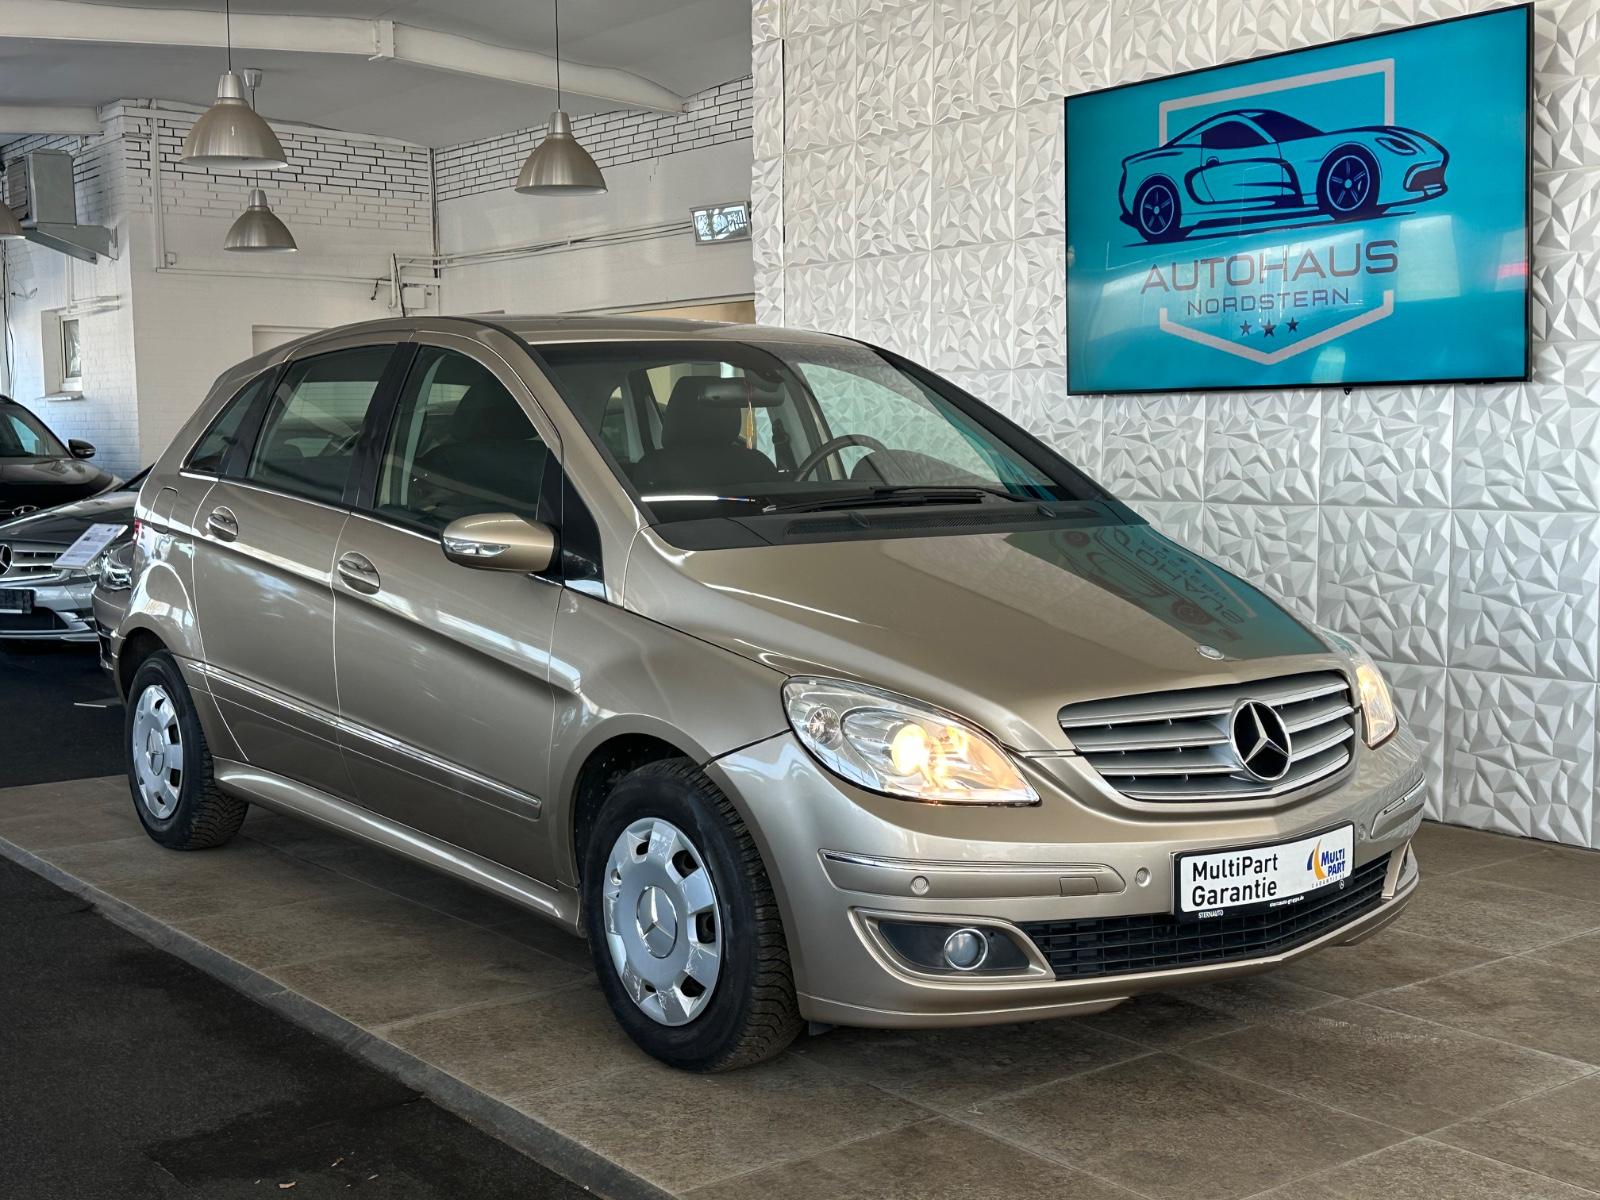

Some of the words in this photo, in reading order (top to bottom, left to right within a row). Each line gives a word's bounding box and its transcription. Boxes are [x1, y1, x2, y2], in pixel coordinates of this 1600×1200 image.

[1140, 239, 1399, 295] AUTOHAUS
[1187, 287, 1349, 316] NORDSTERN
[1192, 853, 1279, 882] MultiPart
[1320, 847, 1345, 867] MULTI
[1327, 860, 1345, 877] PART
[1192, 876, 1278, 907] Garantie
